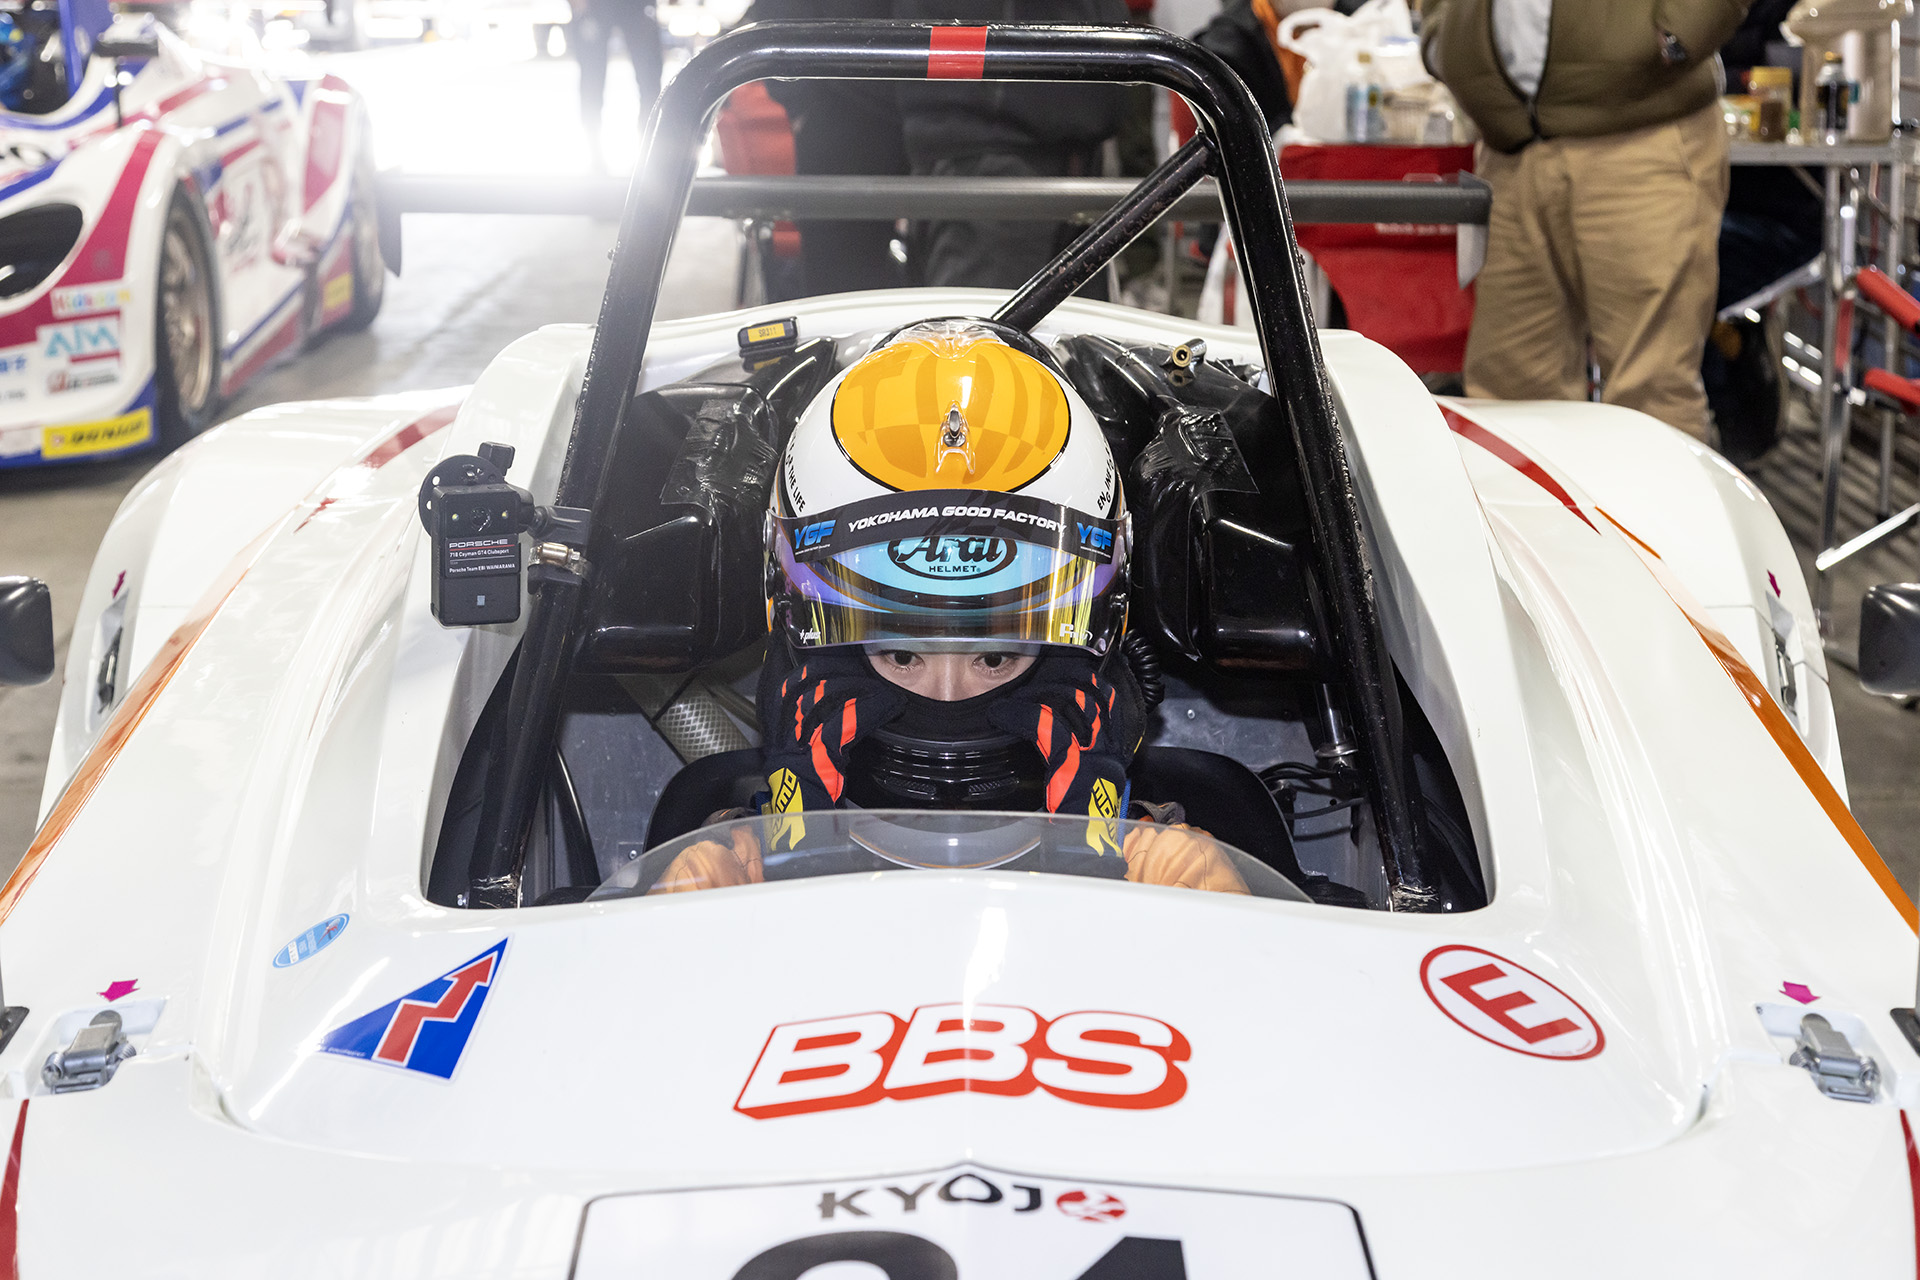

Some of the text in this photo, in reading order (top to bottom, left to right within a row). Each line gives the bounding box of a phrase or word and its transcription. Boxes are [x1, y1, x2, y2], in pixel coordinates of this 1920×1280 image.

[788, 464, 797, 490] THE
[793, 486, 806, 512] LIFE
[448, 538, 508, 549] PORSCHE
[794, 519, 837, 550] YGF
[848, 506, 939, 532] YOKOHAMA
[941, 505, 992, 517] GOOD
[993, 508, 1068, 534] FACTORY
[1076, 521, 1113, 551] YGF
[928, 565, 977, 573] HELMET
[733, 1002, 1192, 1120] BBS
